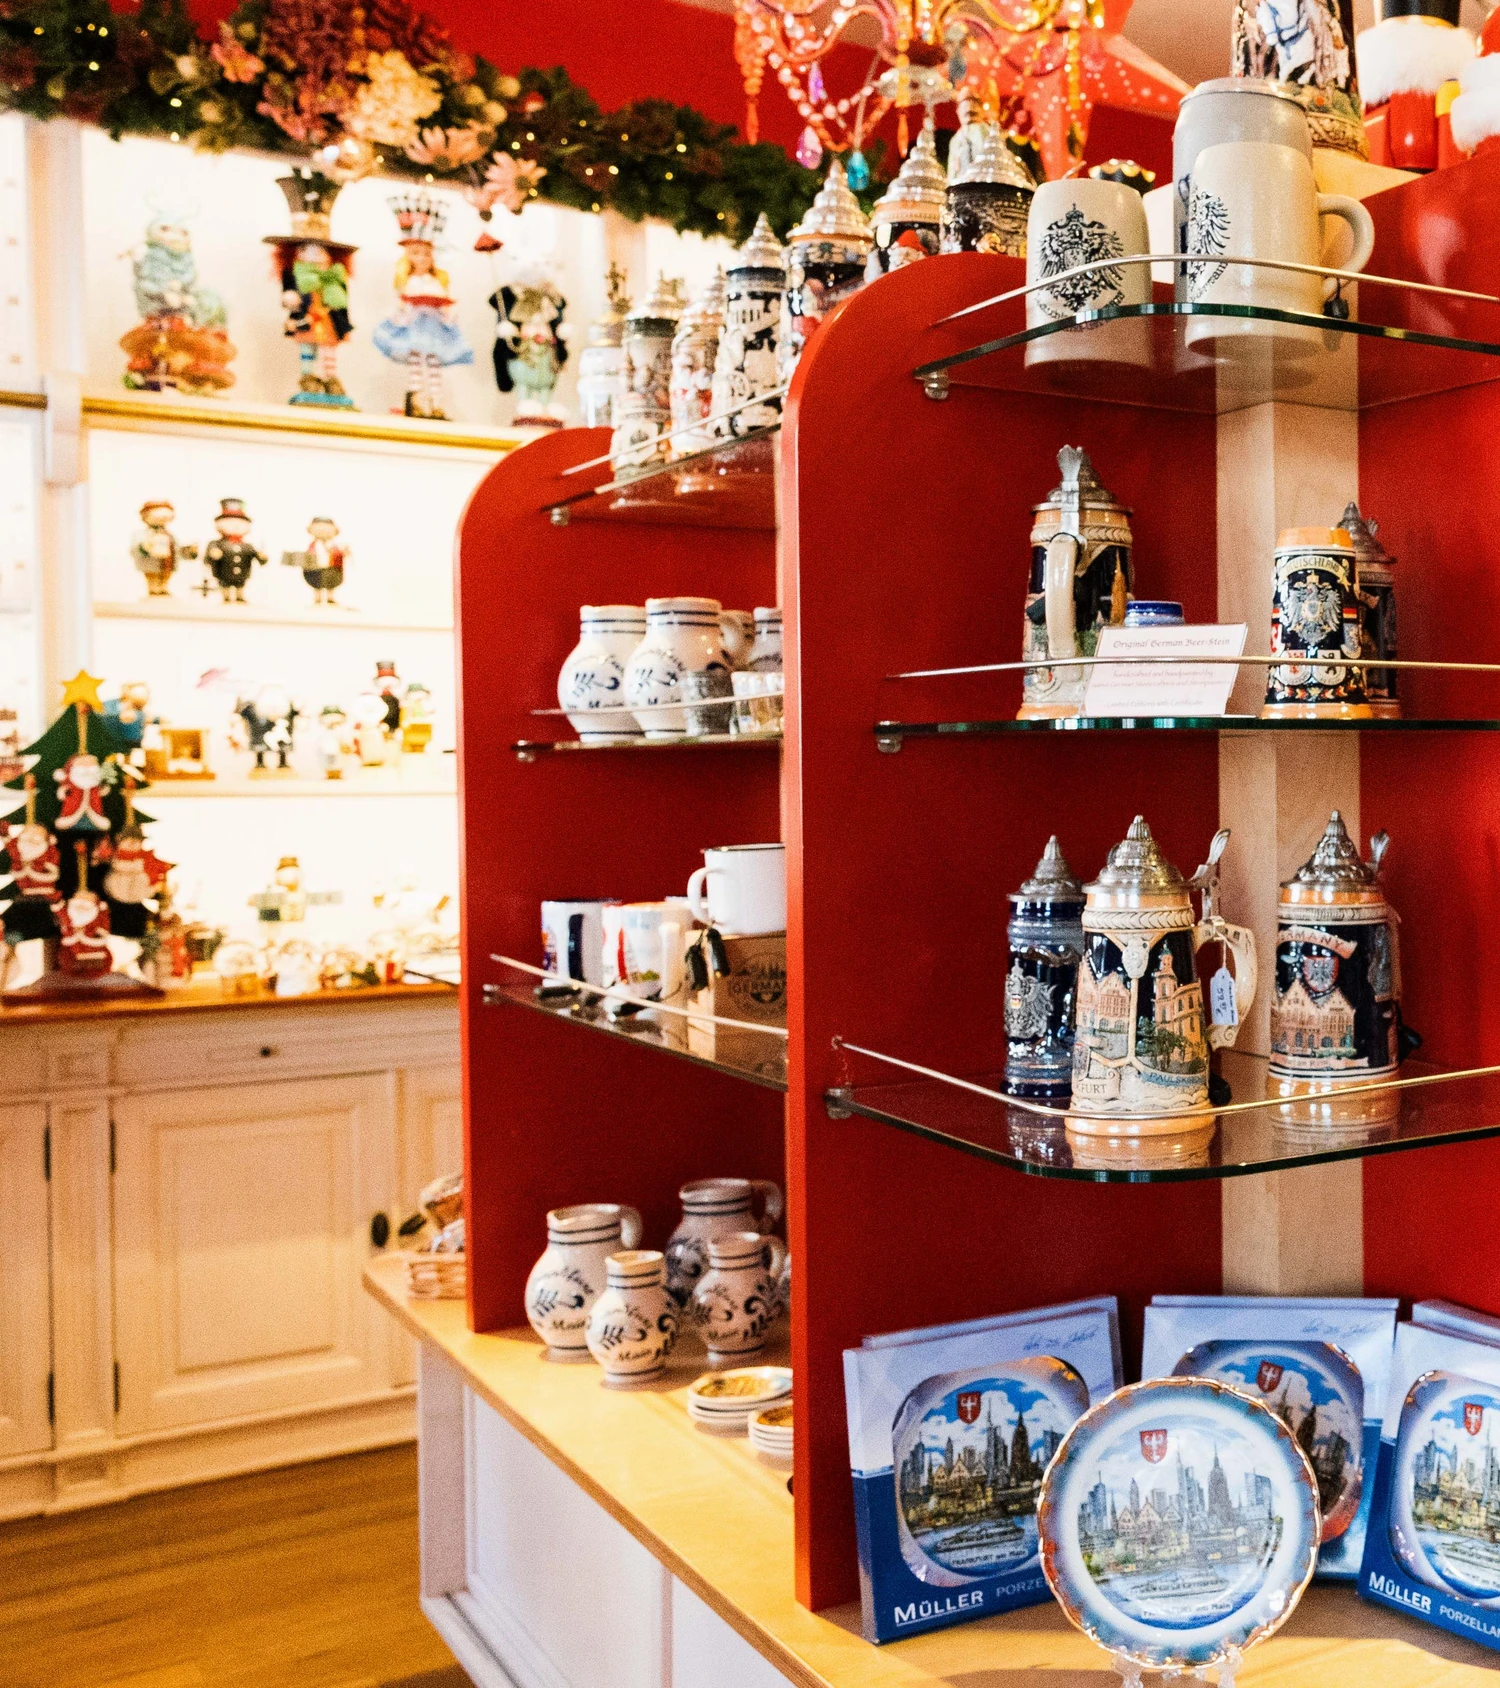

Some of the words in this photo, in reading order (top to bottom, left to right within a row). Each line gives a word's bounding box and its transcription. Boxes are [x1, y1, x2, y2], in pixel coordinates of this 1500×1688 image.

[1113, 640, 1148, 649] Original
[1150, 639, 1183, 648] German
[893, 1590, 984, 1624] MÜLLER
[1368, 1571, 1432, 1611] MÜLLER
